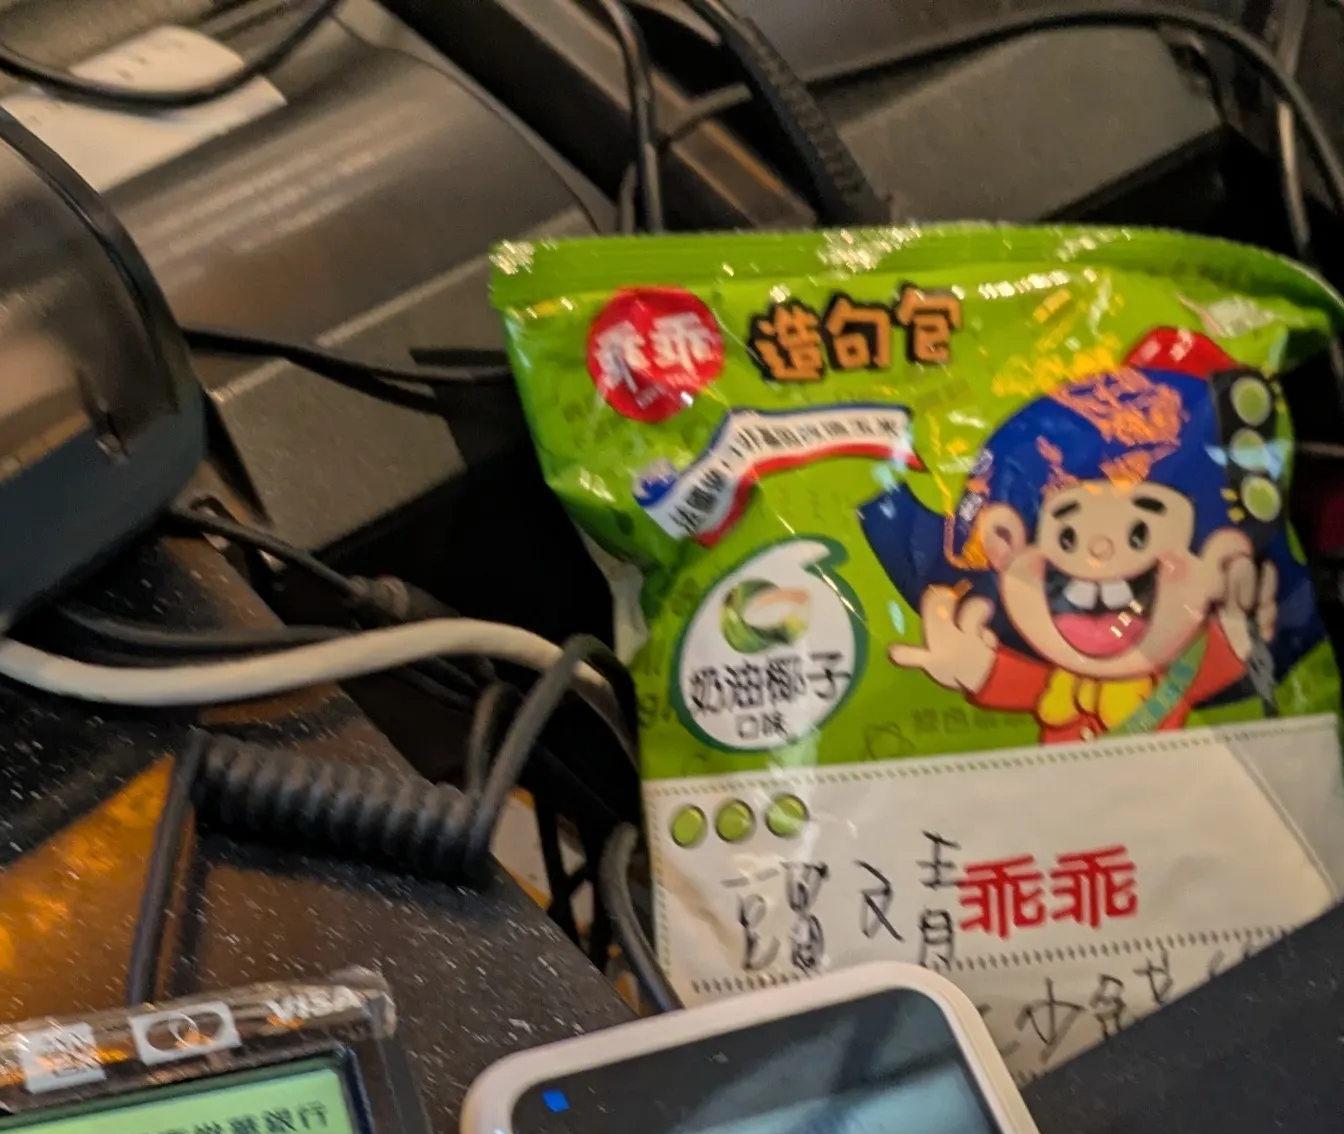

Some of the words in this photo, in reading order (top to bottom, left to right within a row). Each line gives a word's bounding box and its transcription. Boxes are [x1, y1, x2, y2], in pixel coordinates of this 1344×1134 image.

[750, 282, 964, 384] 造句包
[689, 650, 853, 716] 奶油椰子
[734, 710, 790, 743] 口味
[959, 846, 1139, 940] 乖乖
